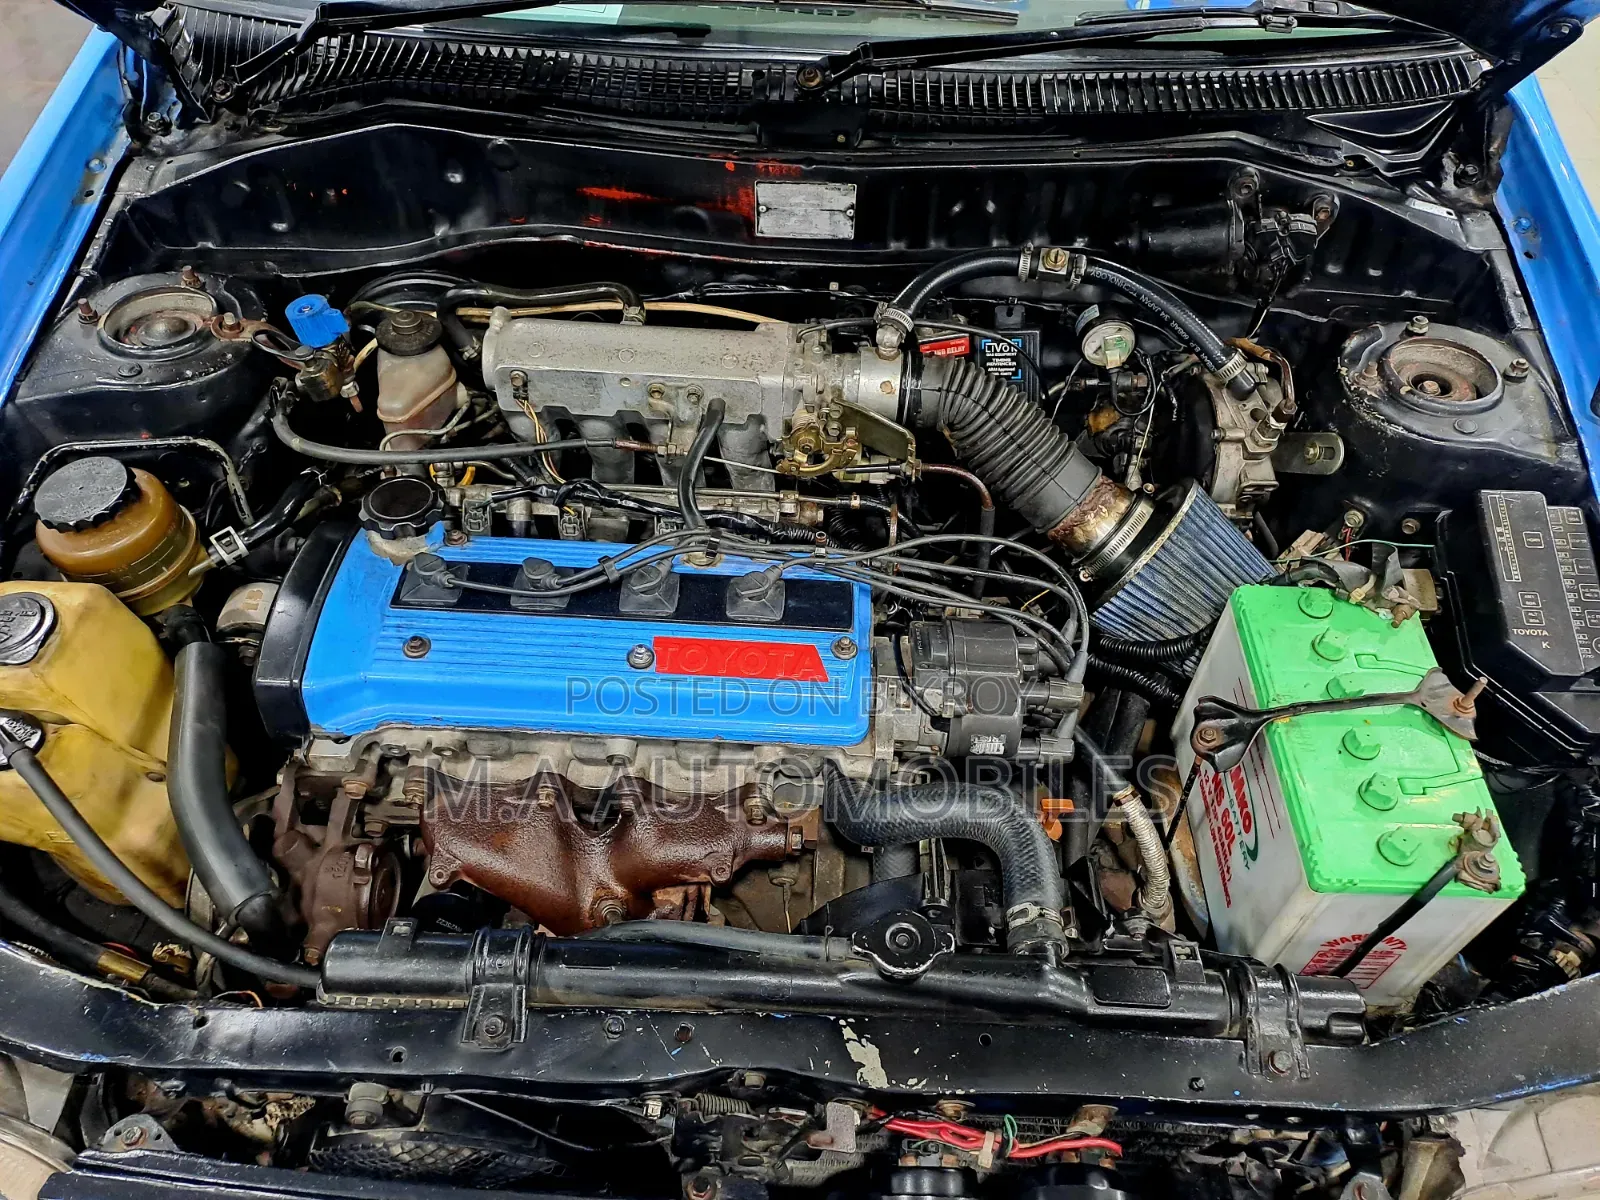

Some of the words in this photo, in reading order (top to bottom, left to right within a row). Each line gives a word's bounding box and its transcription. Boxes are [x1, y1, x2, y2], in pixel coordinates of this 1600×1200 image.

[1089, 267, 1138, 298] TECHNOLOGY
[1140, 295, 1162, 314] JAPAN
[1512, 628, 1549, 636] TOYOTA
[654, 643, 823, 681] TOYOTA
[1229, 798, 1251, 870] BATTERY
